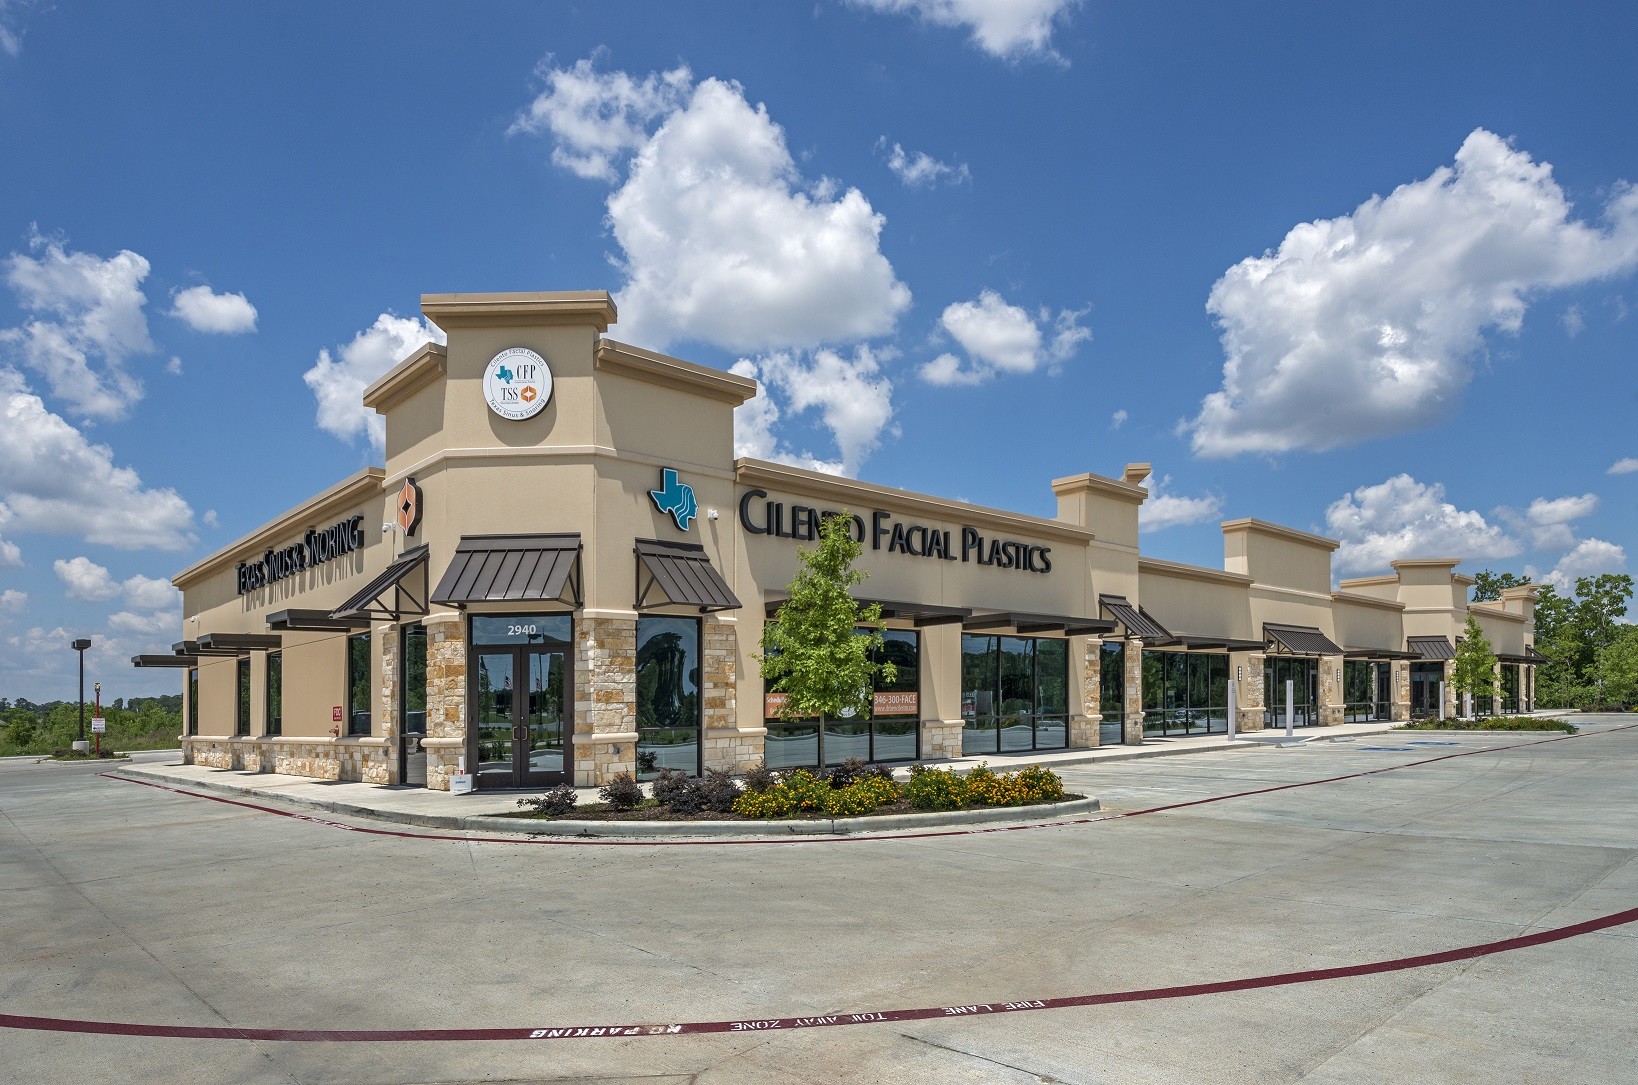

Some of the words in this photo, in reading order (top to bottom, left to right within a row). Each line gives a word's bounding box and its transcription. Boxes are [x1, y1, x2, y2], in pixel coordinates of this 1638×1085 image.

[516, 364, 536, 379] CFP
[501, 387, 519, 401] TSS
[739, 489, 866, 544] CILENO
[303, 515, 365, 568] SNORING
[507, 624, 537, 636] 2940
[794, 1015, 837, 1027] AWAY
[852, 1012, 887, 1022] TOW
[730, 1020, 781, 1031] ZONE
[529, 1027, 640, 1038] PARKING
